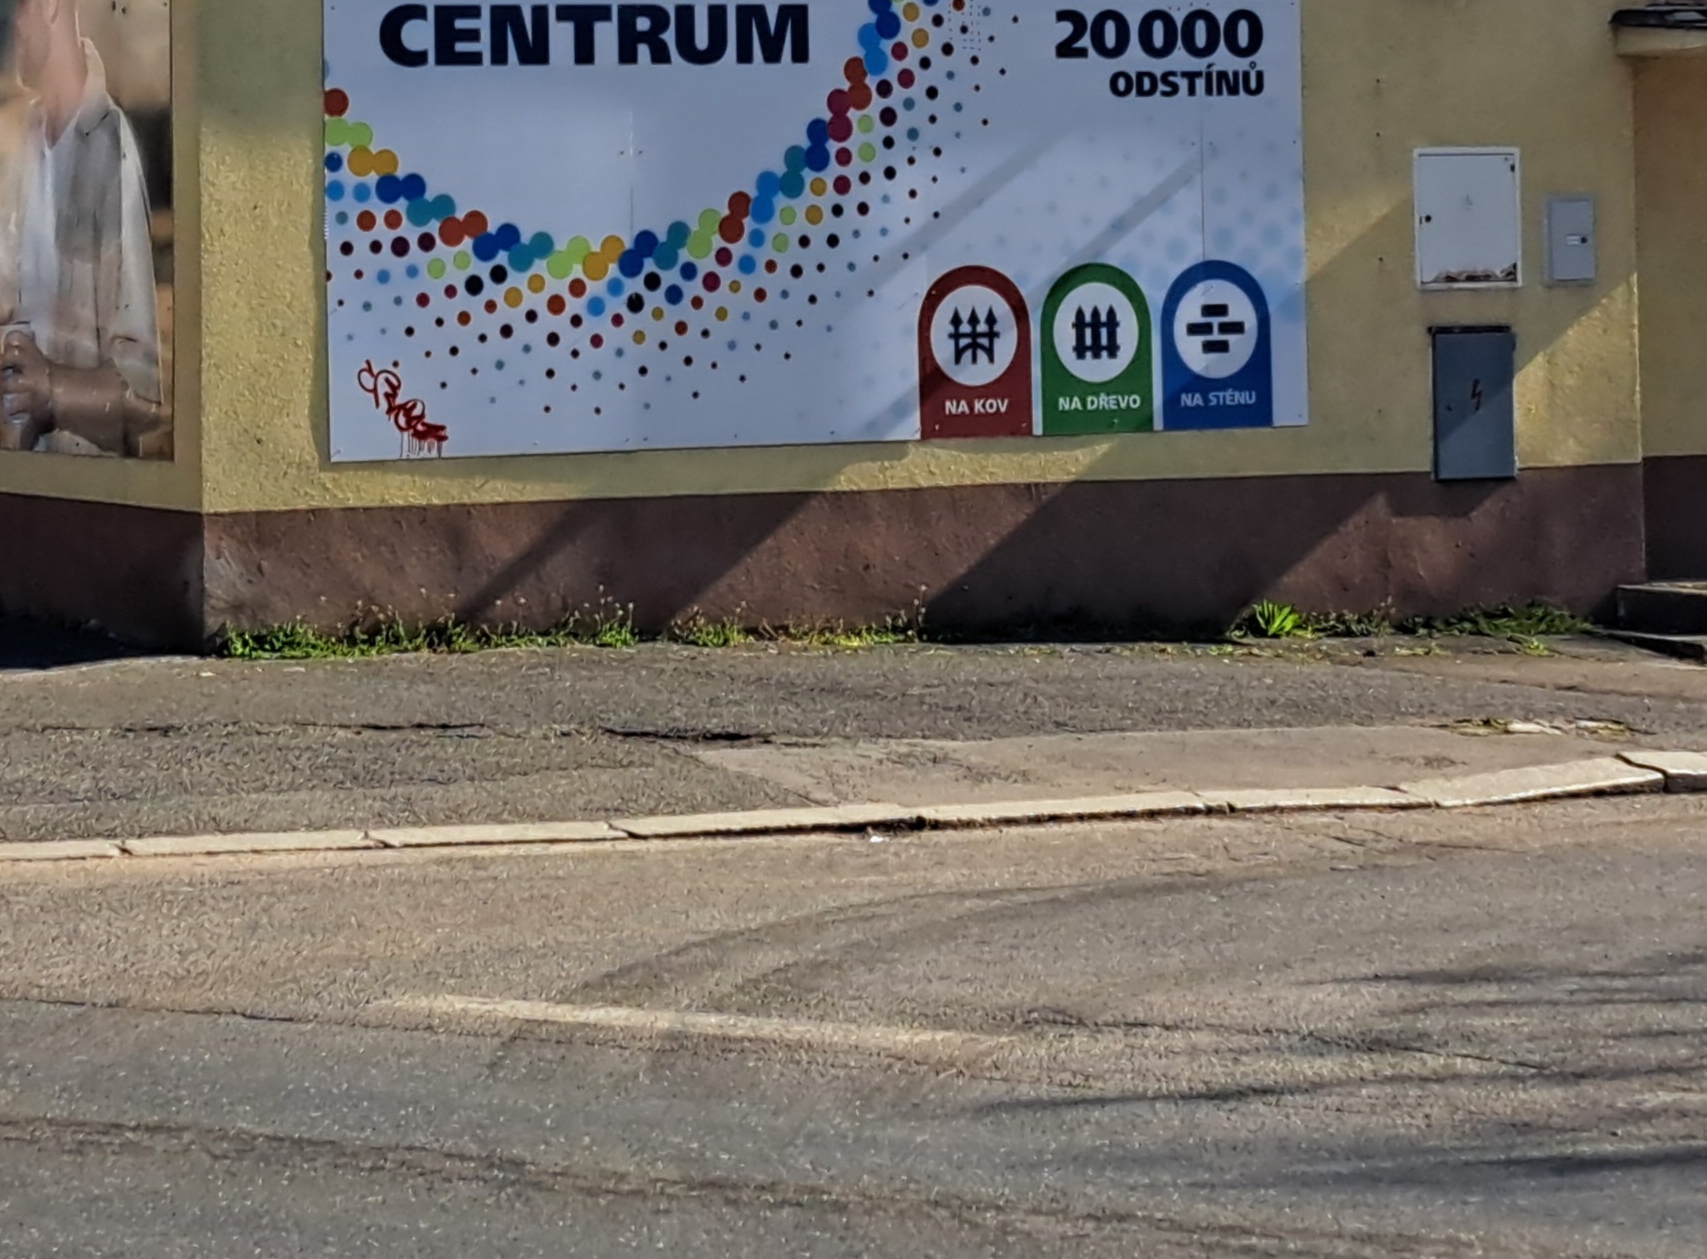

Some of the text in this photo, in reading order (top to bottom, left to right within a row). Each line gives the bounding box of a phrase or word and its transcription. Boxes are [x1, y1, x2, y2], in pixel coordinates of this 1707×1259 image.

[379, 3, 810, 67] CENTRUM
[1109, 60, 1265, 98] ODSTÍNŮ
[945, 398, 1009, 415] NA KOV
[1058, 392, 1141, 412] NA DŘEVO
[1180, 392, 1204, 408] NA
